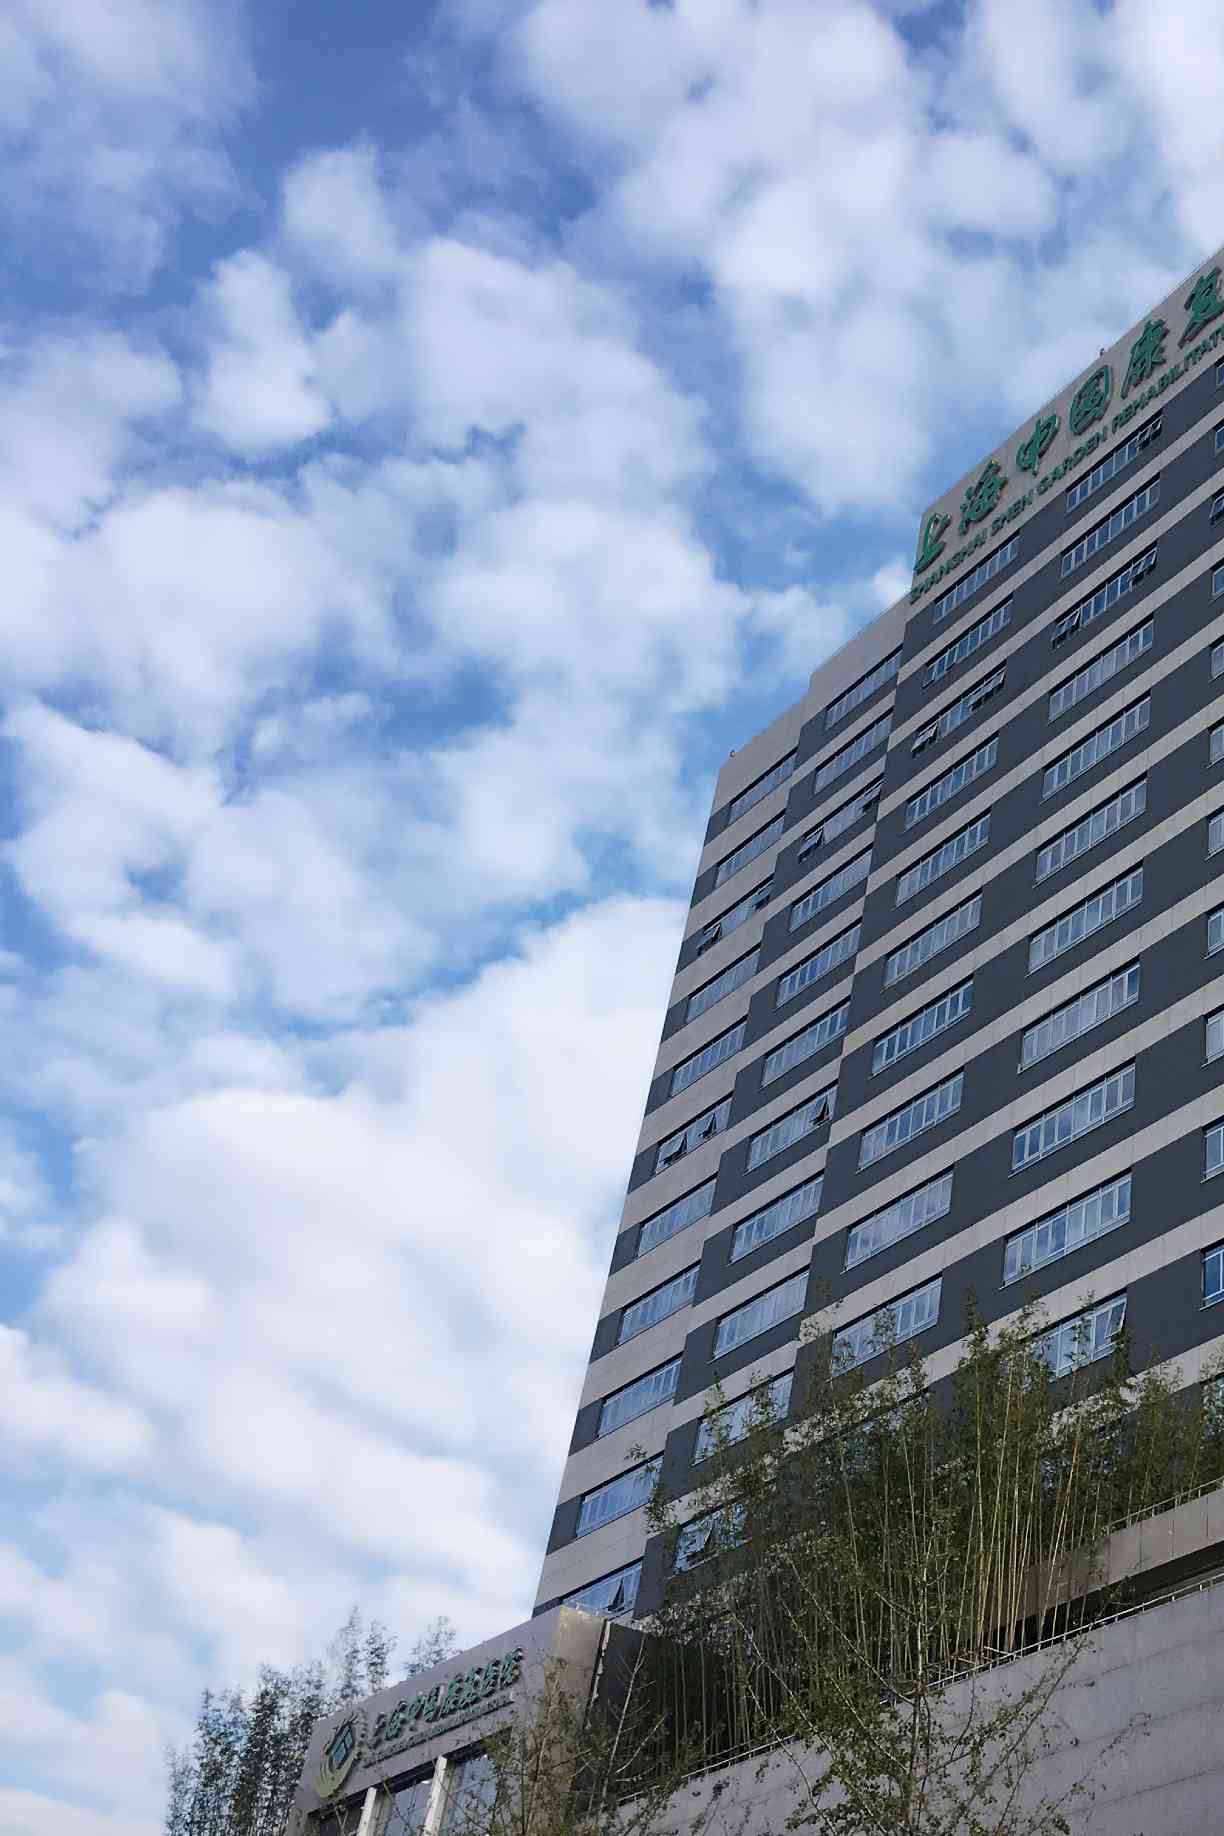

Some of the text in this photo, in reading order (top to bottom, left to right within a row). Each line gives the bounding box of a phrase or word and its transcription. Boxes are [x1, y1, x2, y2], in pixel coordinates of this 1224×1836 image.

[911, 528, 988, 604] SHANGHAI
[991, 488, 1035, 536] SHEN
[1036, 426, 1108, 495] GARDEN
